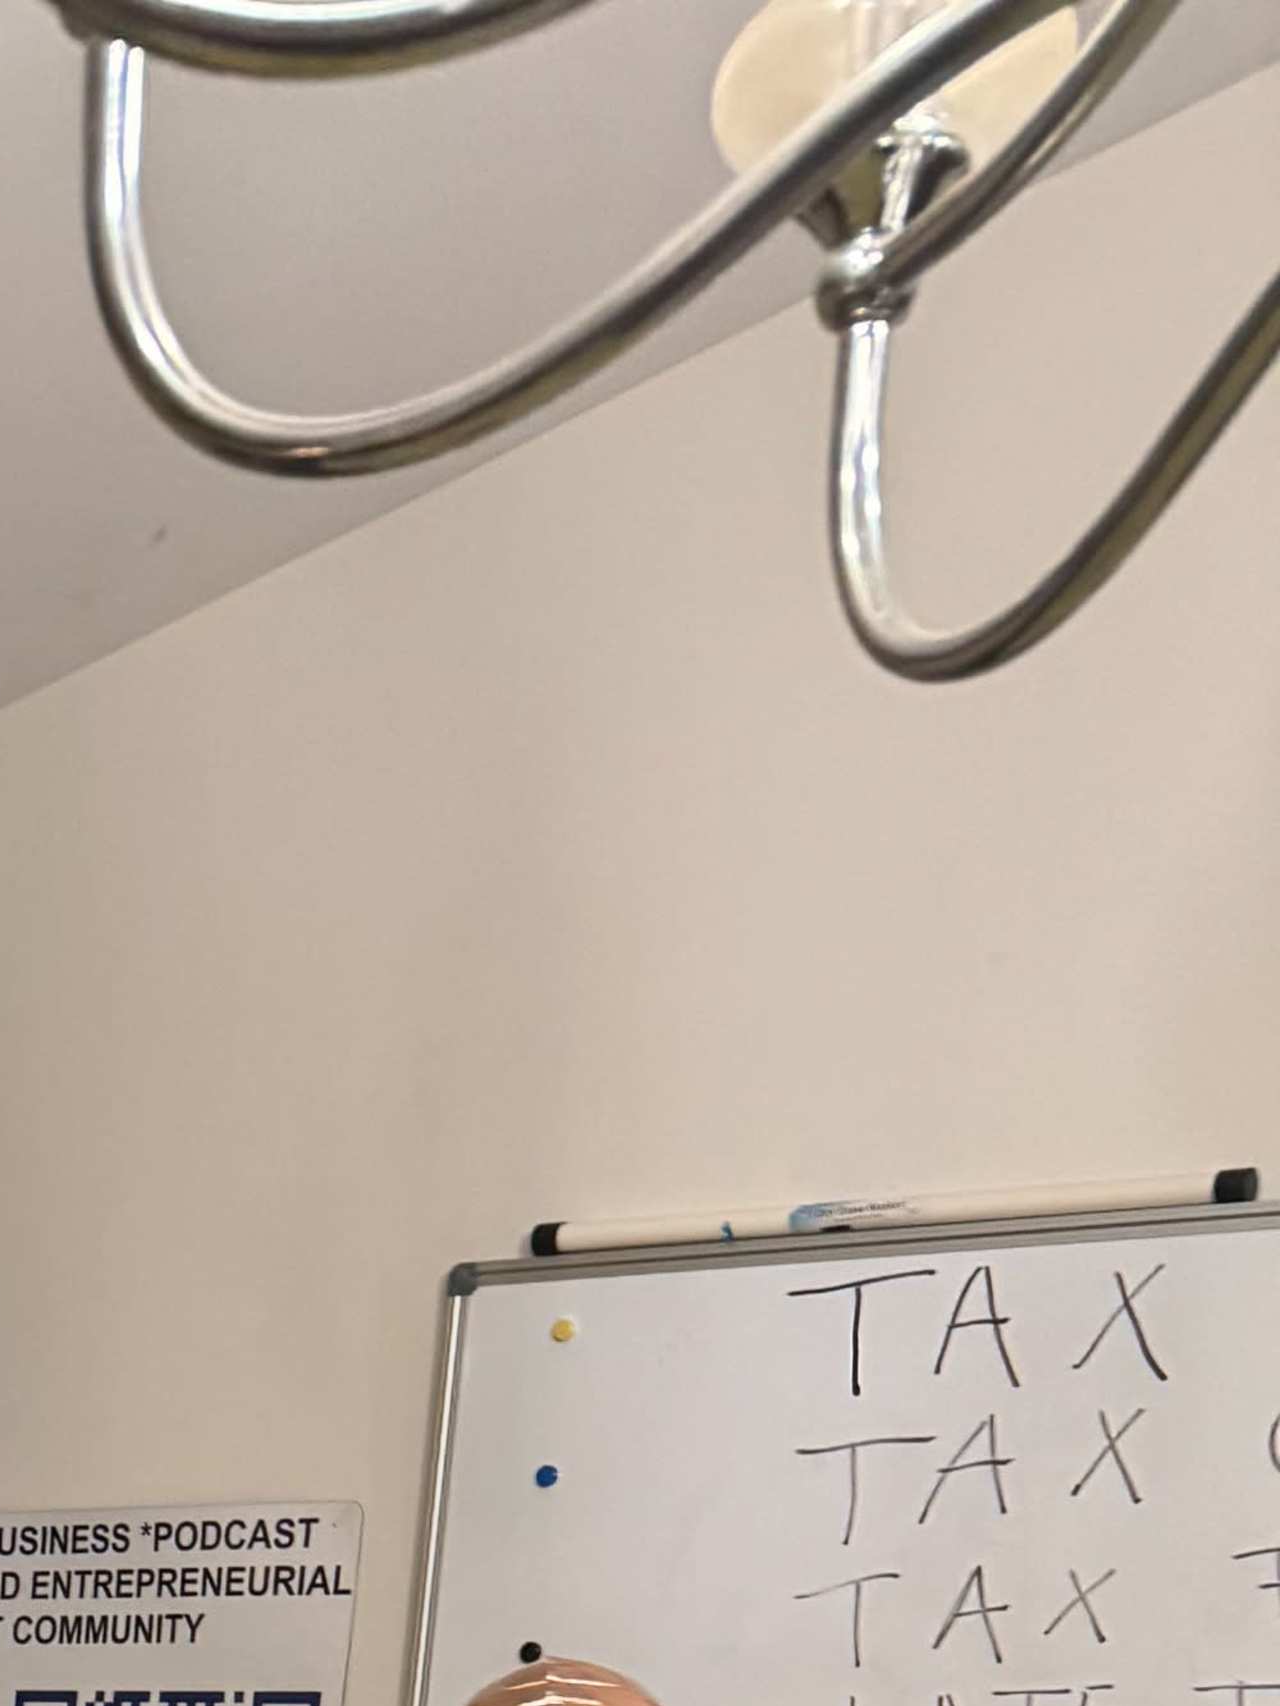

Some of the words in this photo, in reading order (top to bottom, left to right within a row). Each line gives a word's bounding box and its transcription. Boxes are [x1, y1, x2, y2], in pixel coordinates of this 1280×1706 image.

[786, 1263, 1169, 1396] TAX
[794, 1408, 1145, 1545] TAX
[12, 1612, 206, 1646] COMMUNITY
[30, 1564, 352, 1600] ENTREPRENEURIAL
[794, 1565, 1117, 1667] TAX
